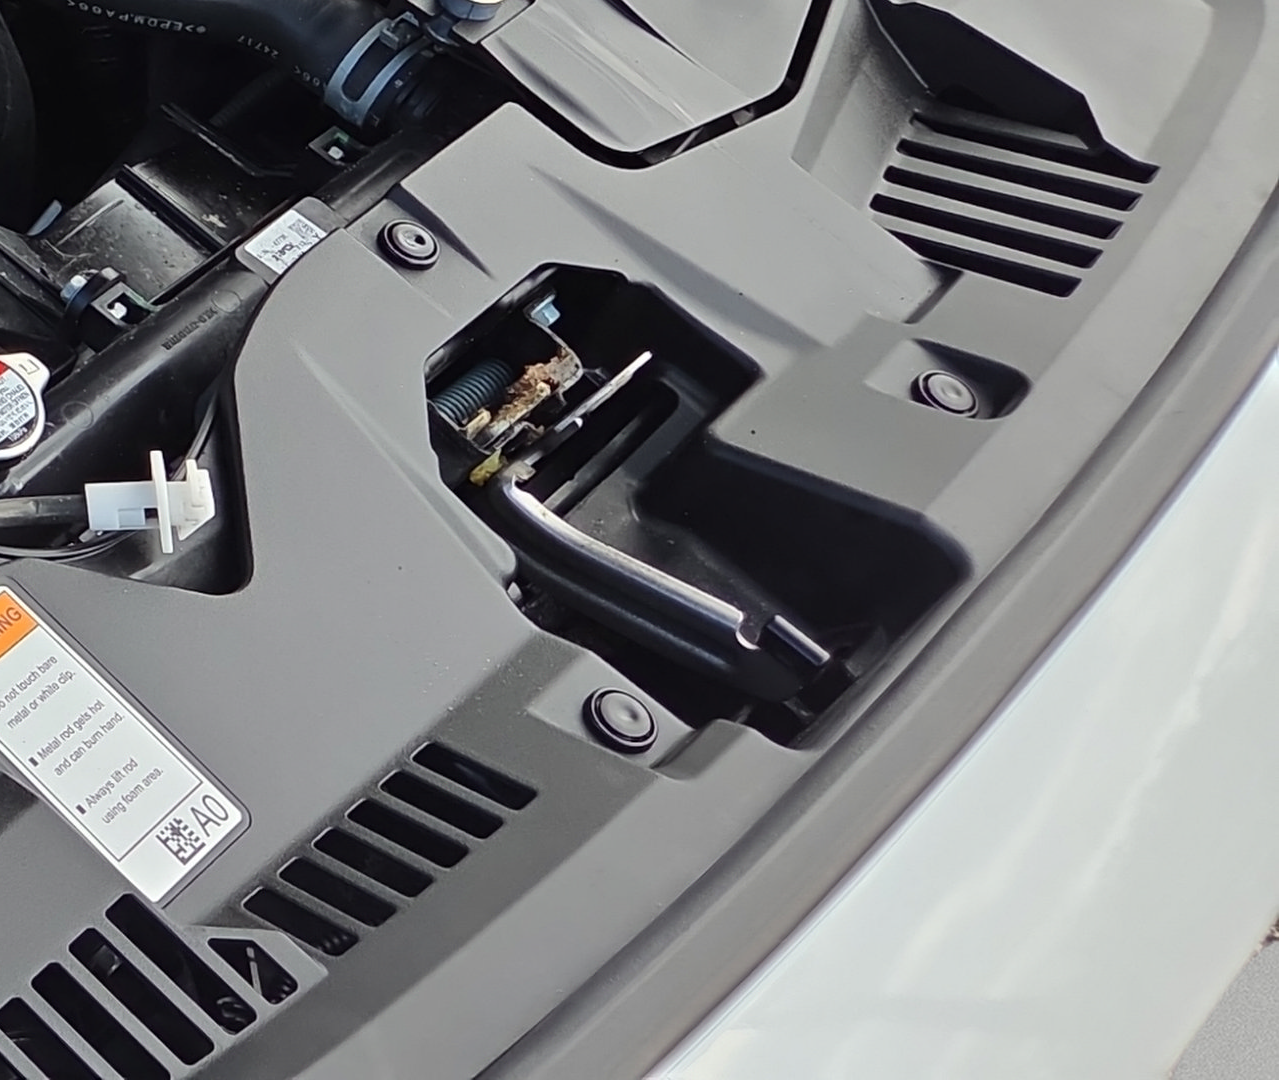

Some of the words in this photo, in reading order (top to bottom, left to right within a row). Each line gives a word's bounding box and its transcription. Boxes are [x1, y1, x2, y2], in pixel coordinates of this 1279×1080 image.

[4, 687, 20, 702] not
[16, 670, 41, 691] touch
[37, 656, 58, 675] bare
[7, 705, 32, 729] metal
[28, 698, 41, 711] or
[37, 682, 61, 703] white
[57, 669, 76, 686] clip.
[37, 737, 63, 760] Metal
[59, 724, 76, 741] rod
[73, 712, 93, 732] gets
[89, 699, 106, 716] hot
[54, 758, 72, 776] and
[69, 745, 86, 762] can
[82, 729, 104, 750] burn
[101, 711, 125, 734] hand.
[85, 781, 117, 809] Always
[110, 768, 125, 785] lift
[122, 757, 139, 775] rod
[102, 800, 128, 824] using
[122, 782, 146, 804] foam
[142, 766, 164, 786] area.
[189, 794, 230, 838] A0
